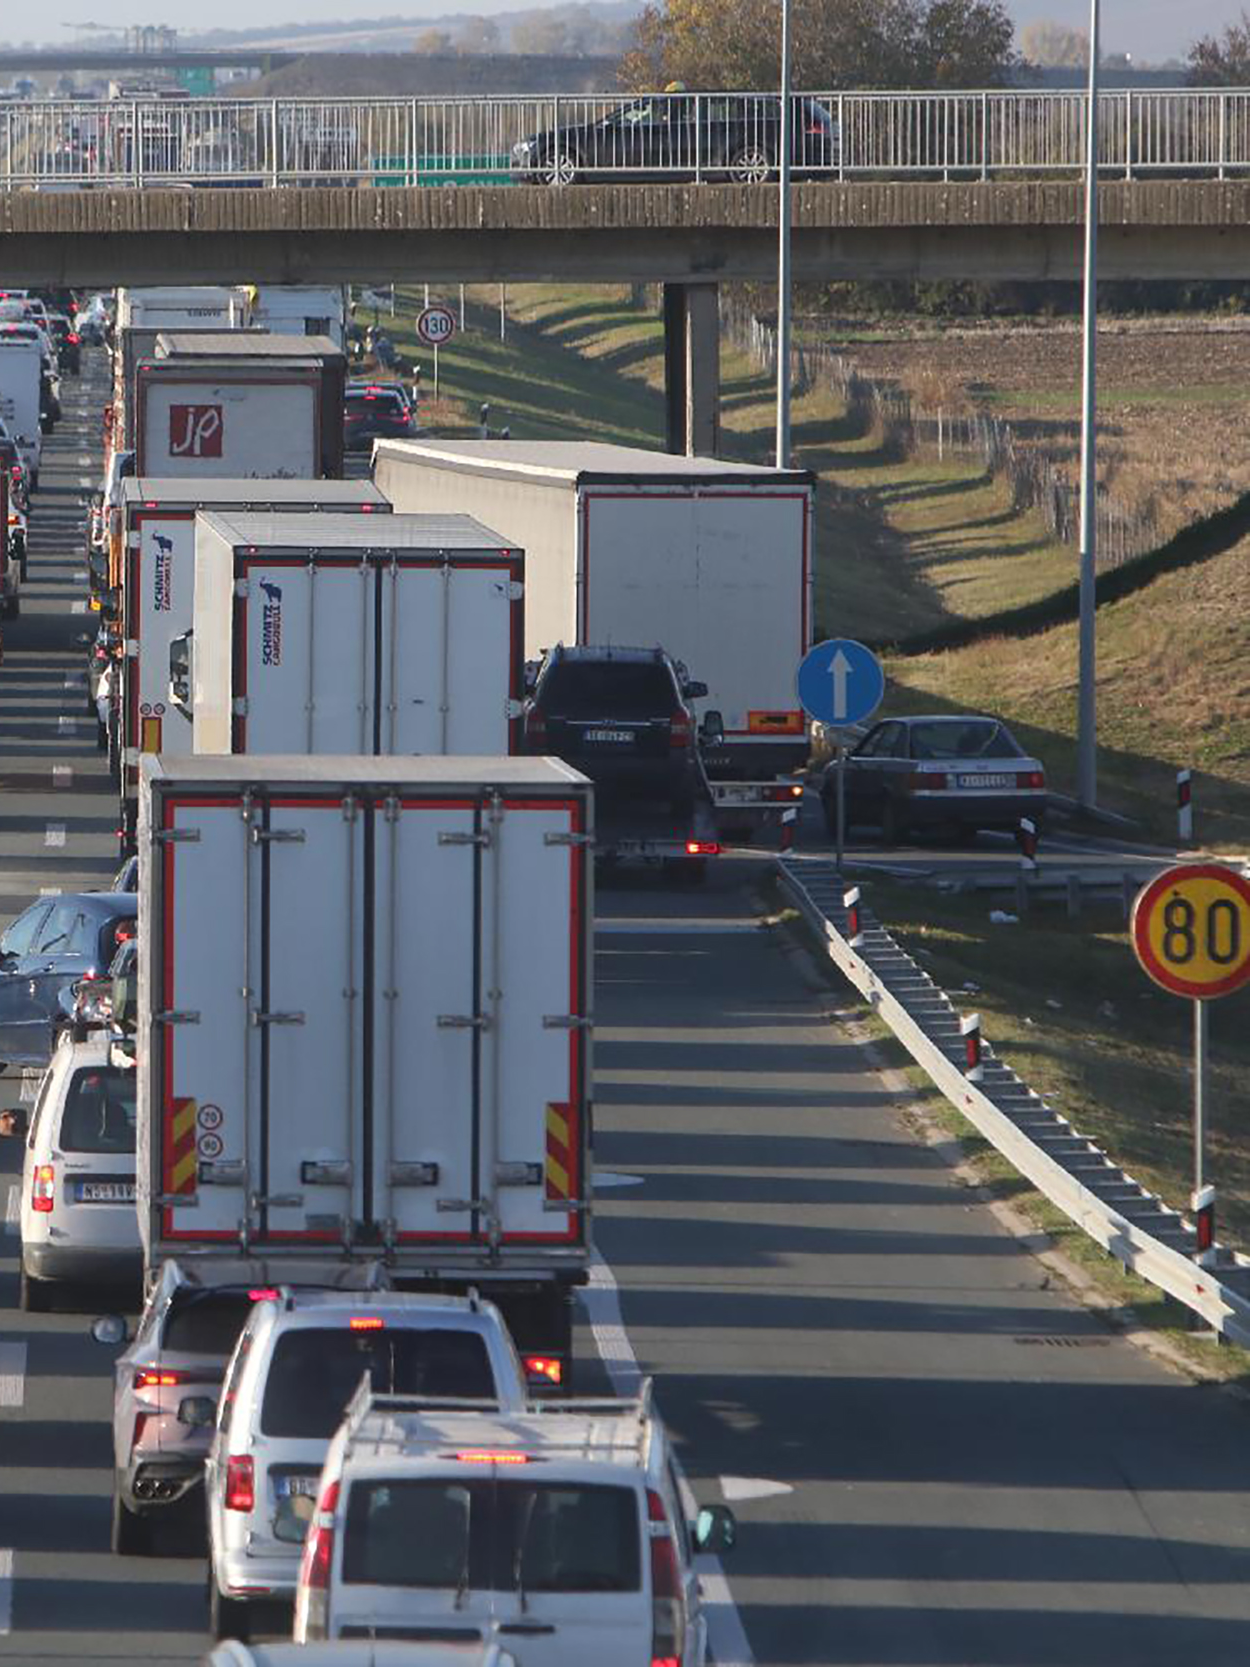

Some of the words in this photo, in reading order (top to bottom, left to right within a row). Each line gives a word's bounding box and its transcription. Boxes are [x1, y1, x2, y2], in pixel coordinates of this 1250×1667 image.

[424, 316, 449, 334] 130
[154, 554, 164, 611] SCHMITZ
[163, 555, 172, 612] CARGOBULL
[262, 605, 273, 666] SCHMITZ
[272, 604, 282, 666] CARGOBULL
[1163, 897, 1241, 965] 80
